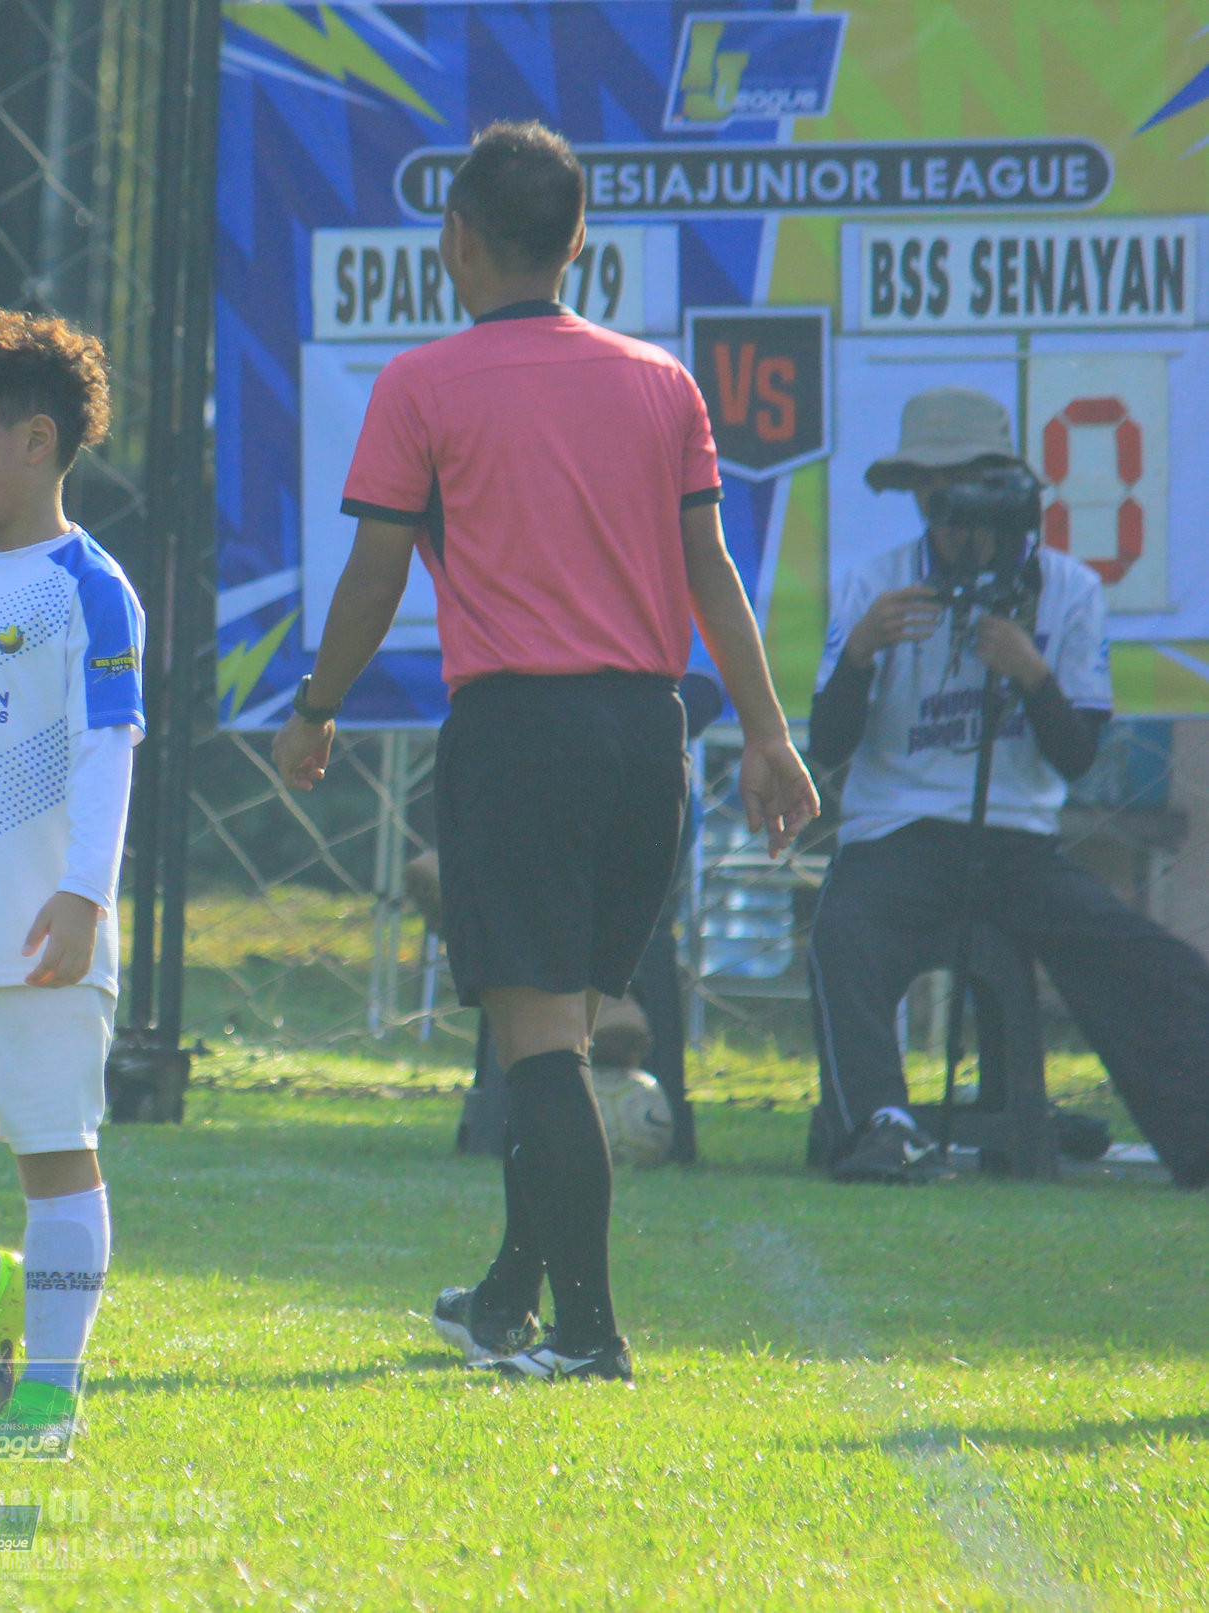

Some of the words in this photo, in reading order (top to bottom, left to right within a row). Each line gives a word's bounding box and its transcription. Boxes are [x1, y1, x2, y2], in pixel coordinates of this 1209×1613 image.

[899, 156, 1087, 200] LEAGUE
[336, 245, 466, 324] SPAR
[870, 238, 950, 319] BSS
[969, 236, 1185, 316] SENAYAN
[714, 343, 796, 441] VS
